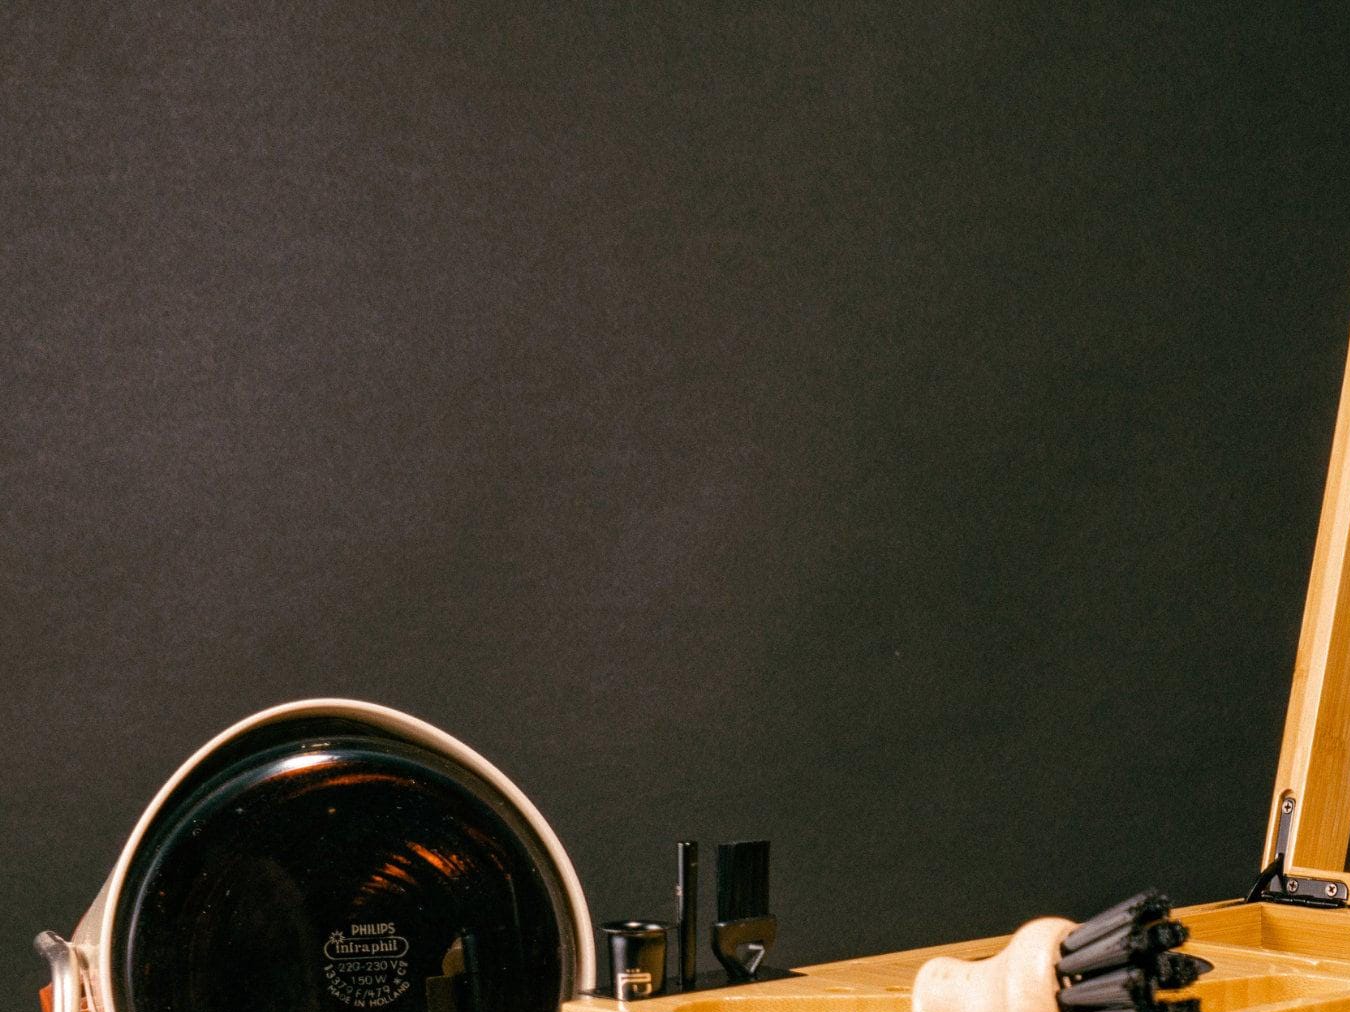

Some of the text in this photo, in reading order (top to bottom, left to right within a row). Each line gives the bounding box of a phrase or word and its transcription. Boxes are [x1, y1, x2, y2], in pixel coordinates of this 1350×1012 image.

[351, 922, 396, 936] PHILIPS
[338, 960, 398, 973] 220-230 V
[351, 974, 387, 986] 150 W
[328, 981, 411, 1007] MADE IN HOLLAND
